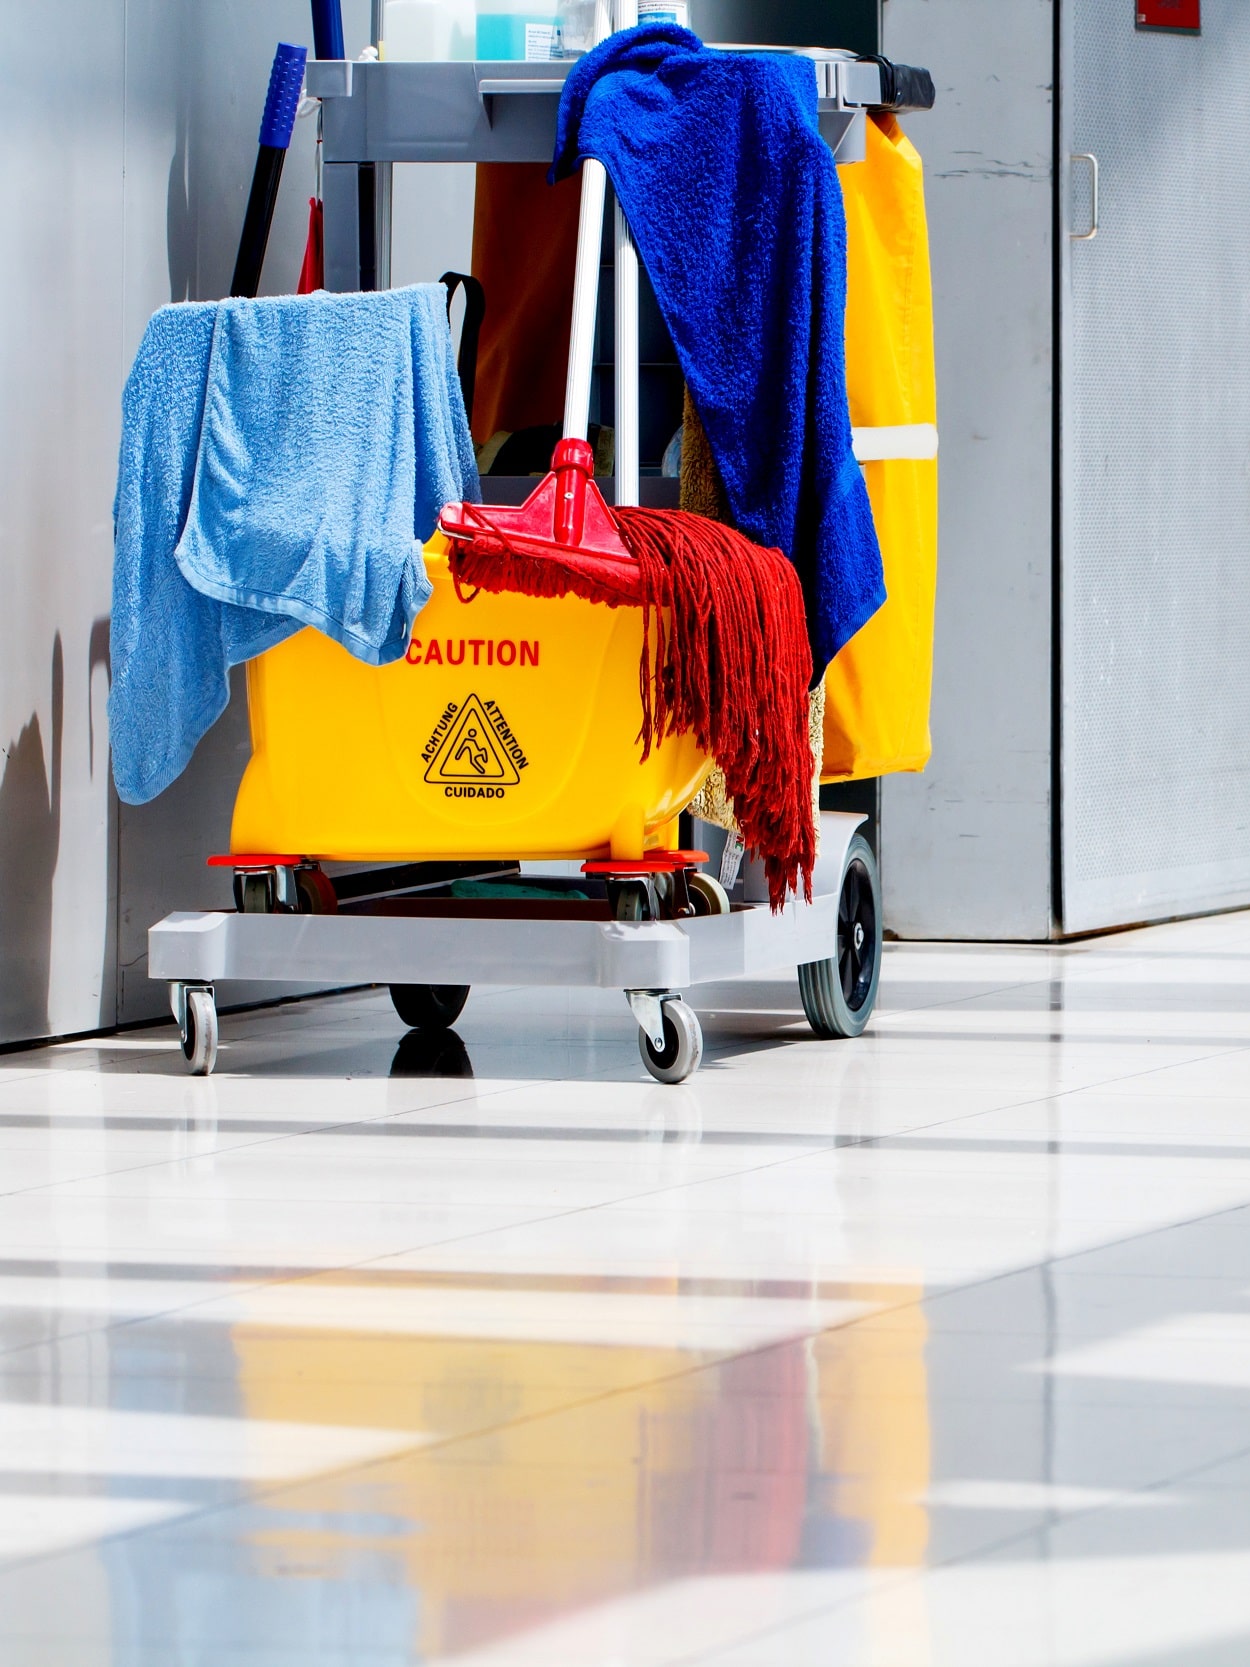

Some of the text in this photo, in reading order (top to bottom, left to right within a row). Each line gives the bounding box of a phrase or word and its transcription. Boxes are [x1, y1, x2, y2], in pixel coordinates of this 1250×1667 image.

[405, 638, 539, 666] CAUTION
[421, 702, 458, 763] ACHTUNG
[484, 700, 529, 770] ATTENTION
[444, 787, 505, 799] CUIDADO
